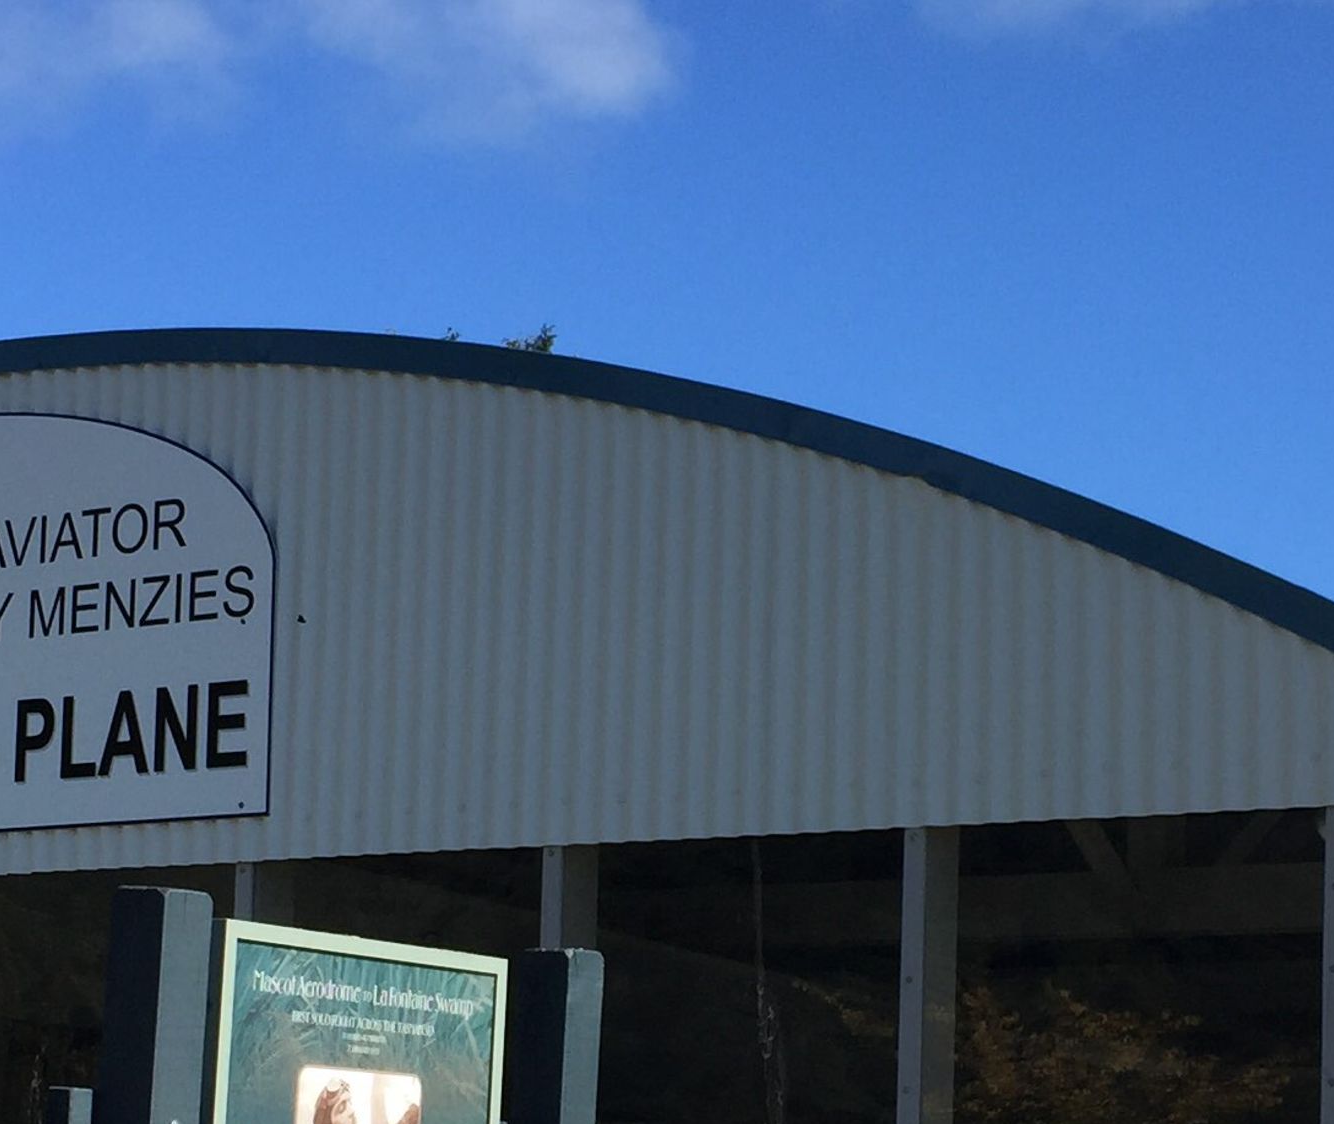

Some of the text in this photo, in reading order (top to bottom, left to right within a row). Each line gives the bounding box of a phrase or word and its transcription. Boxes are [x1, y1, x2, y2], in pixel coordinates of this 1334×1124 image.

[28, 565, 255, 639] MENZIES
[14, 679, 249, 783] PLANE
[252, 969, 296, 996] Mascot
[296, 975, 361, 1003] Aerodrome
[388, 986, 434, 1012] Fontaine
[434, 992, 473, 1020] Swamp
